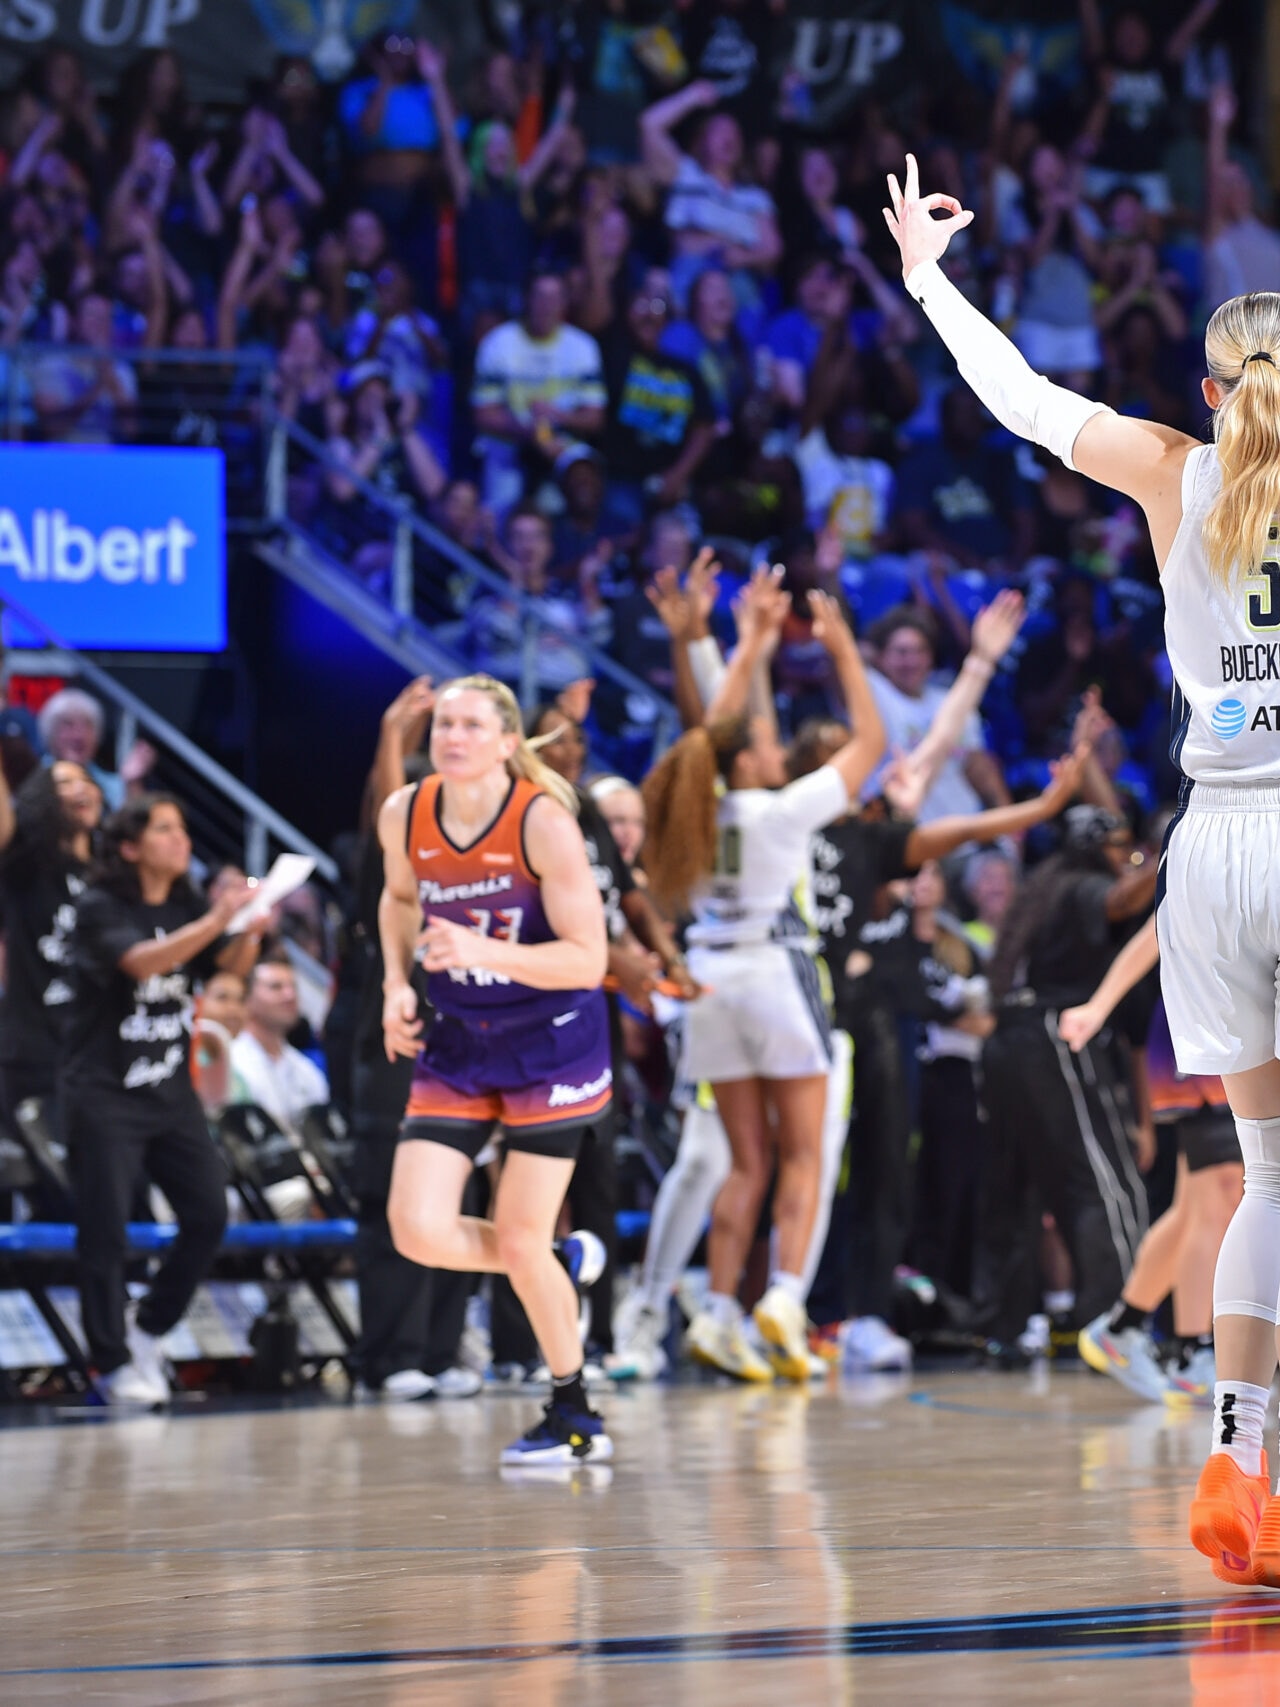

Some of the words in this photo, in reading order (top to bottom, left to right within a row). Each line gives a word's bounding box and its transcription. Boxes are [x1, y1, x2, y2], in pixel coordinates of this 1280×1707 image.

[80, 0, 200, 47] UP
[793, 20, 903, 85] UP
[0, 507, 197, 585] Albert
